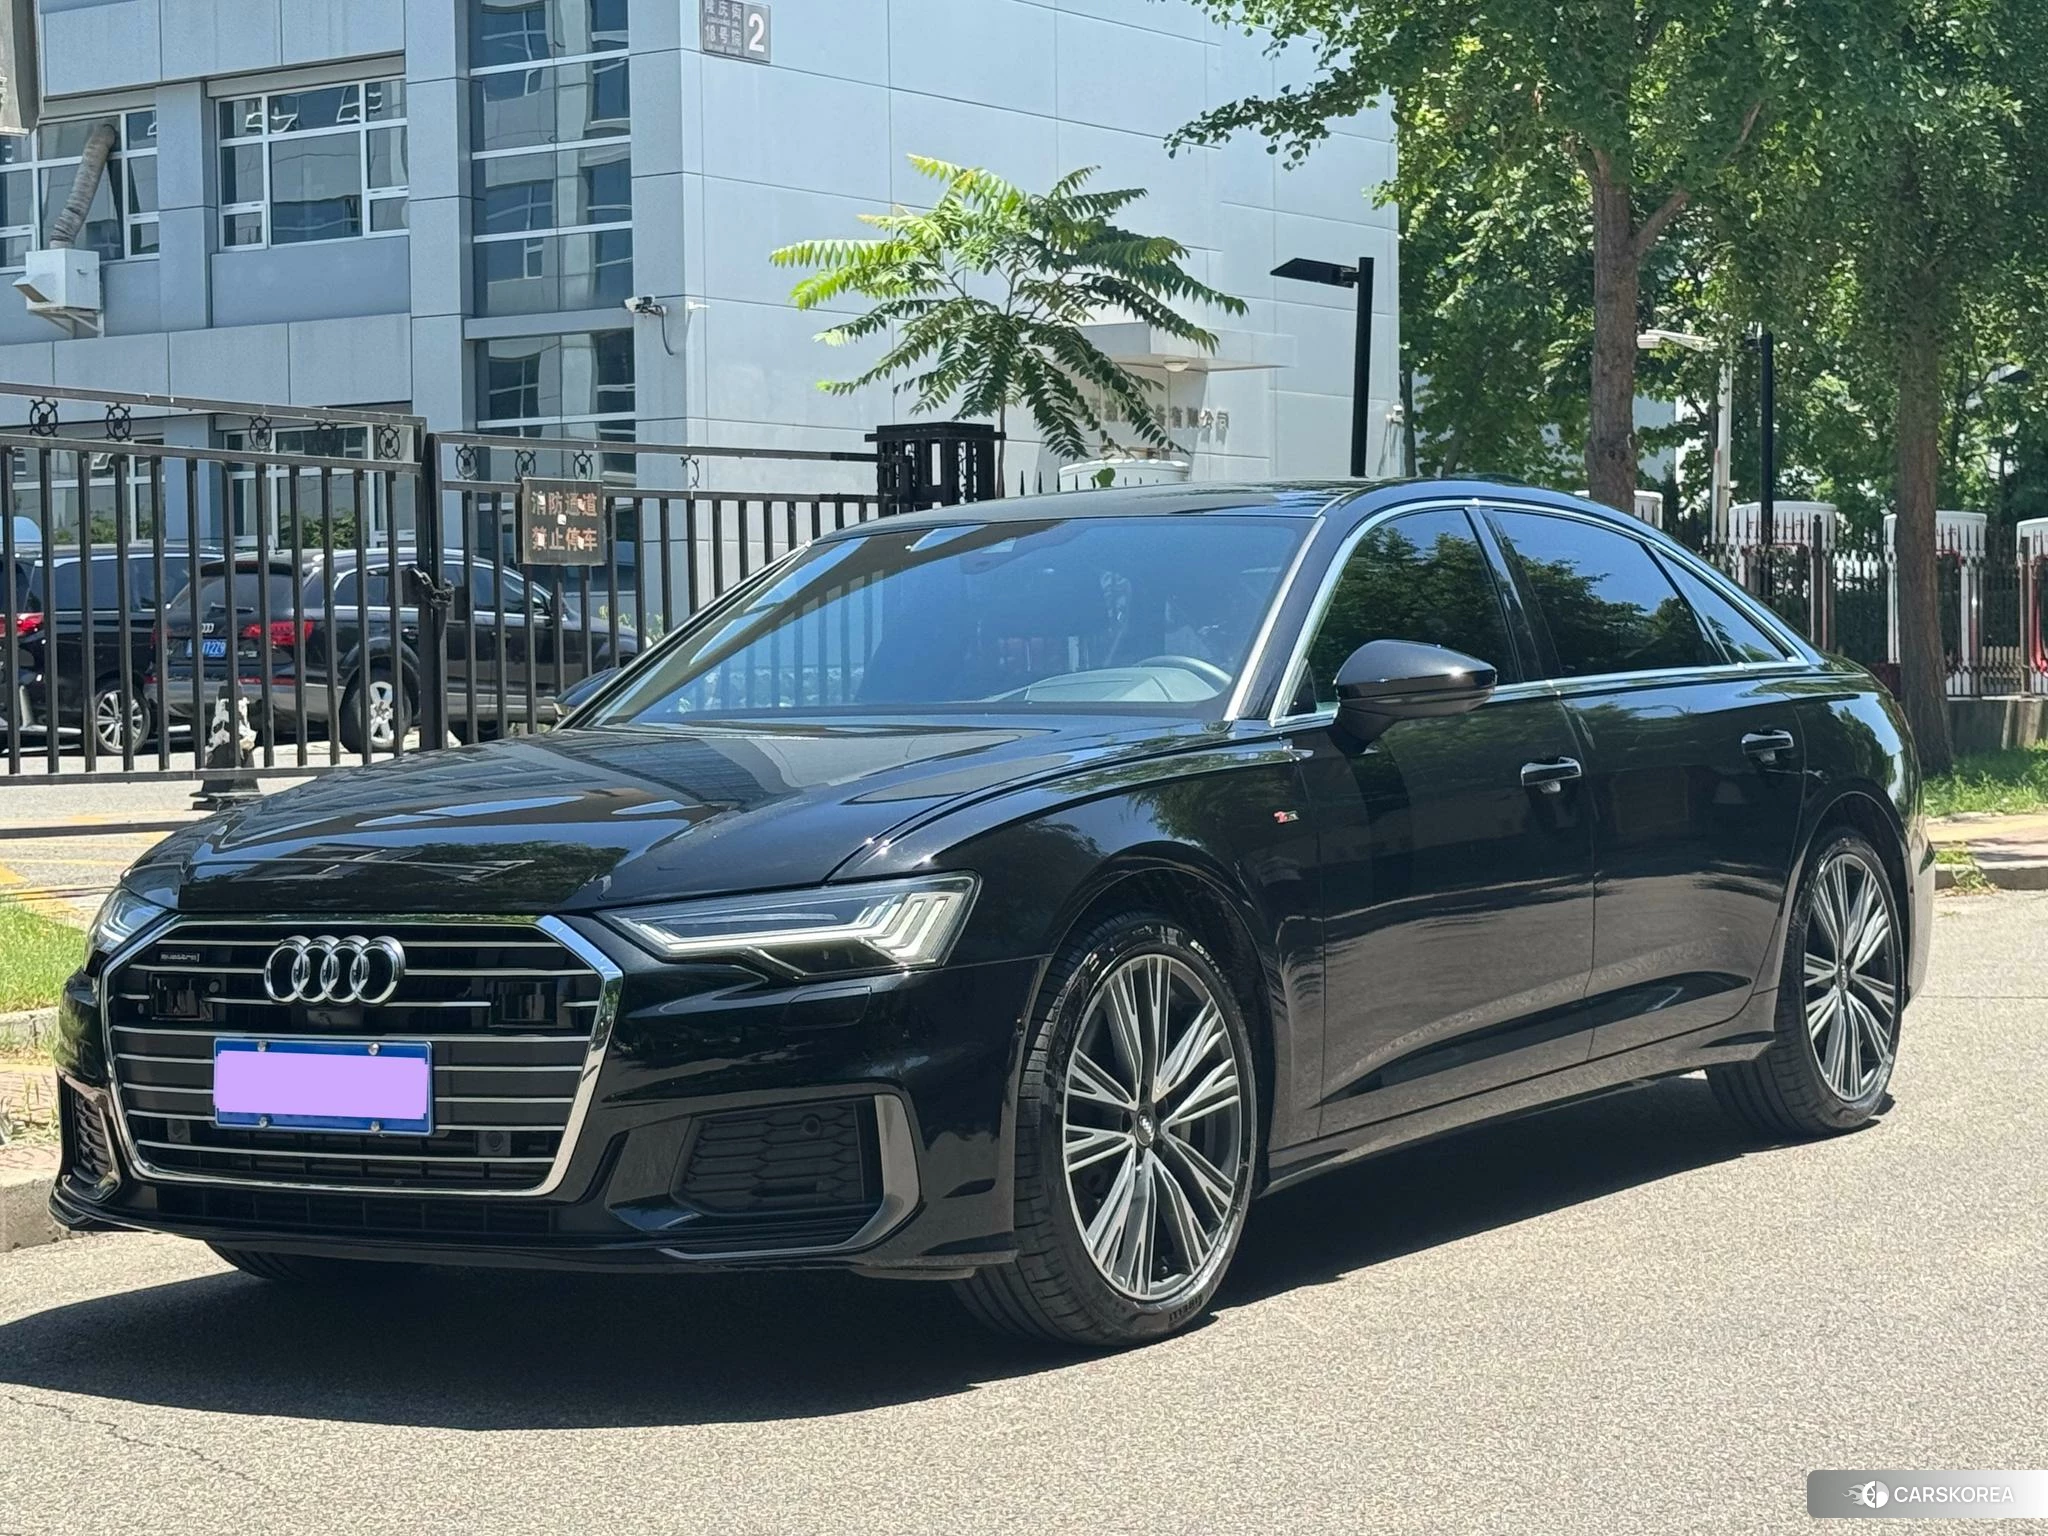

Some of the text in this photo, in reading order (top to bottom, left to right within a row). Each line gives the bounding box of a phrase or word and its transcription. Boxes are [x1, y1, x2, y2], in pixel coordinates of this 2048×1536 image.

[748, 12, 765, 53] 2
[531, 490, 597, 516] 消防通道
[531, 526, 598, 552] 禁止停车
